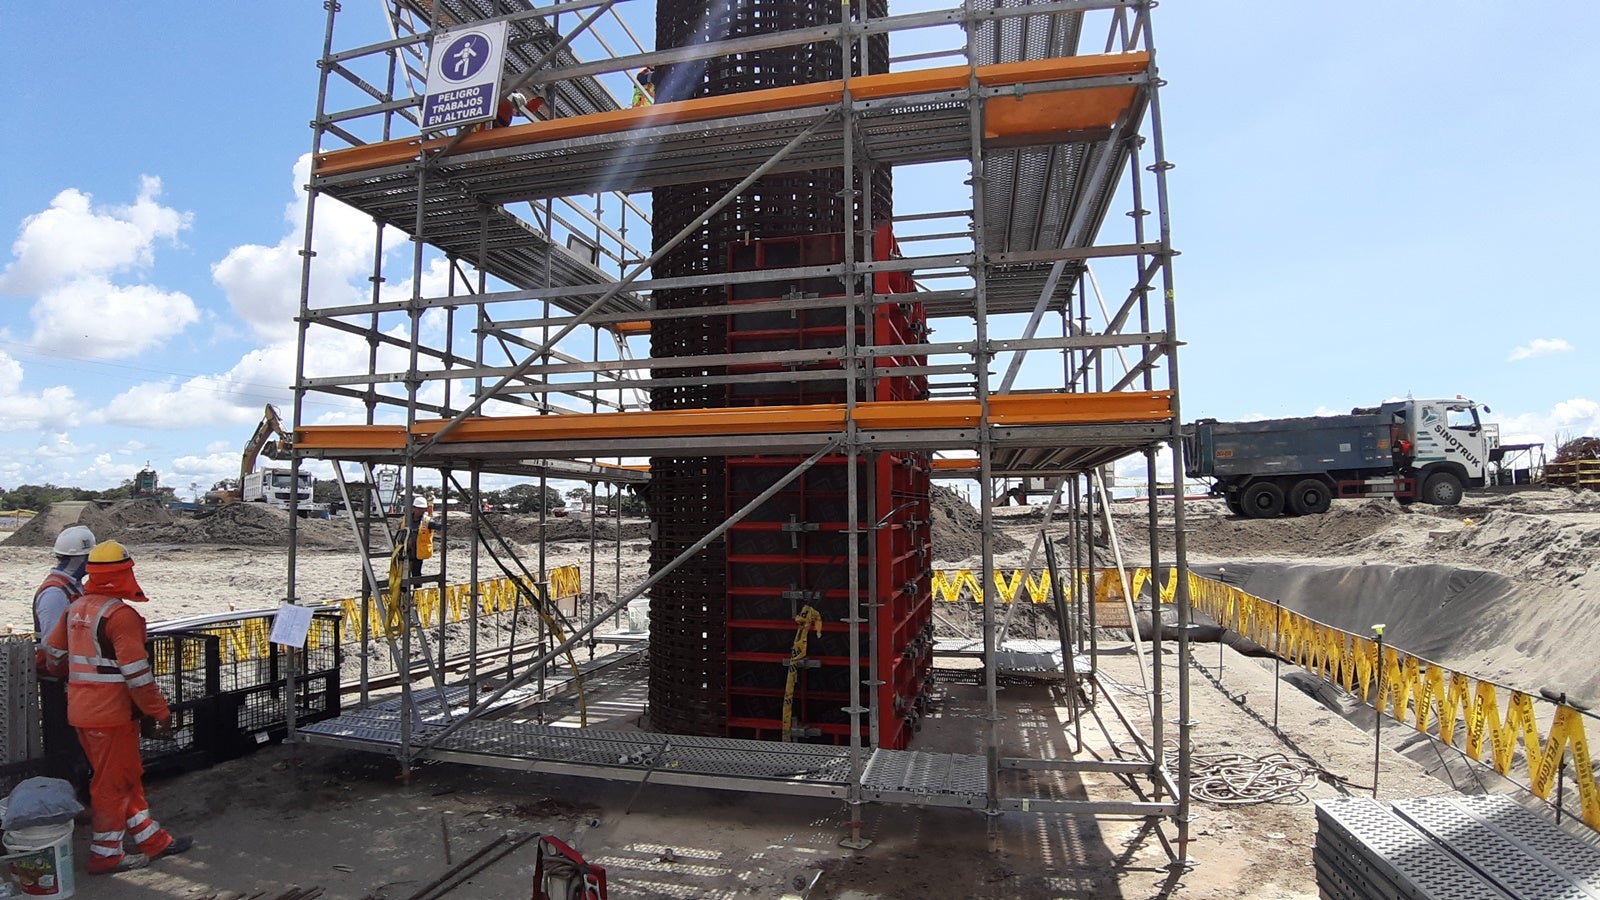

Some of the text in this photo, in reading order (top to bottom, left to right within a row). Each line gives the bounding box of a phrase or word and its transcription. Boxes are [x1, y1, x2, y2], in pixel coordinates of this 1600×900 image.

[438, 87, 480, 103] PELIGRO
[432, 97, 483, 114] TRABAJOS
[429, 107, 483, 126] EN ALTURA
[1434, 424, 1480, 468] SINOTRUK
[1537, 737, 1560, 793] PELIGRO
